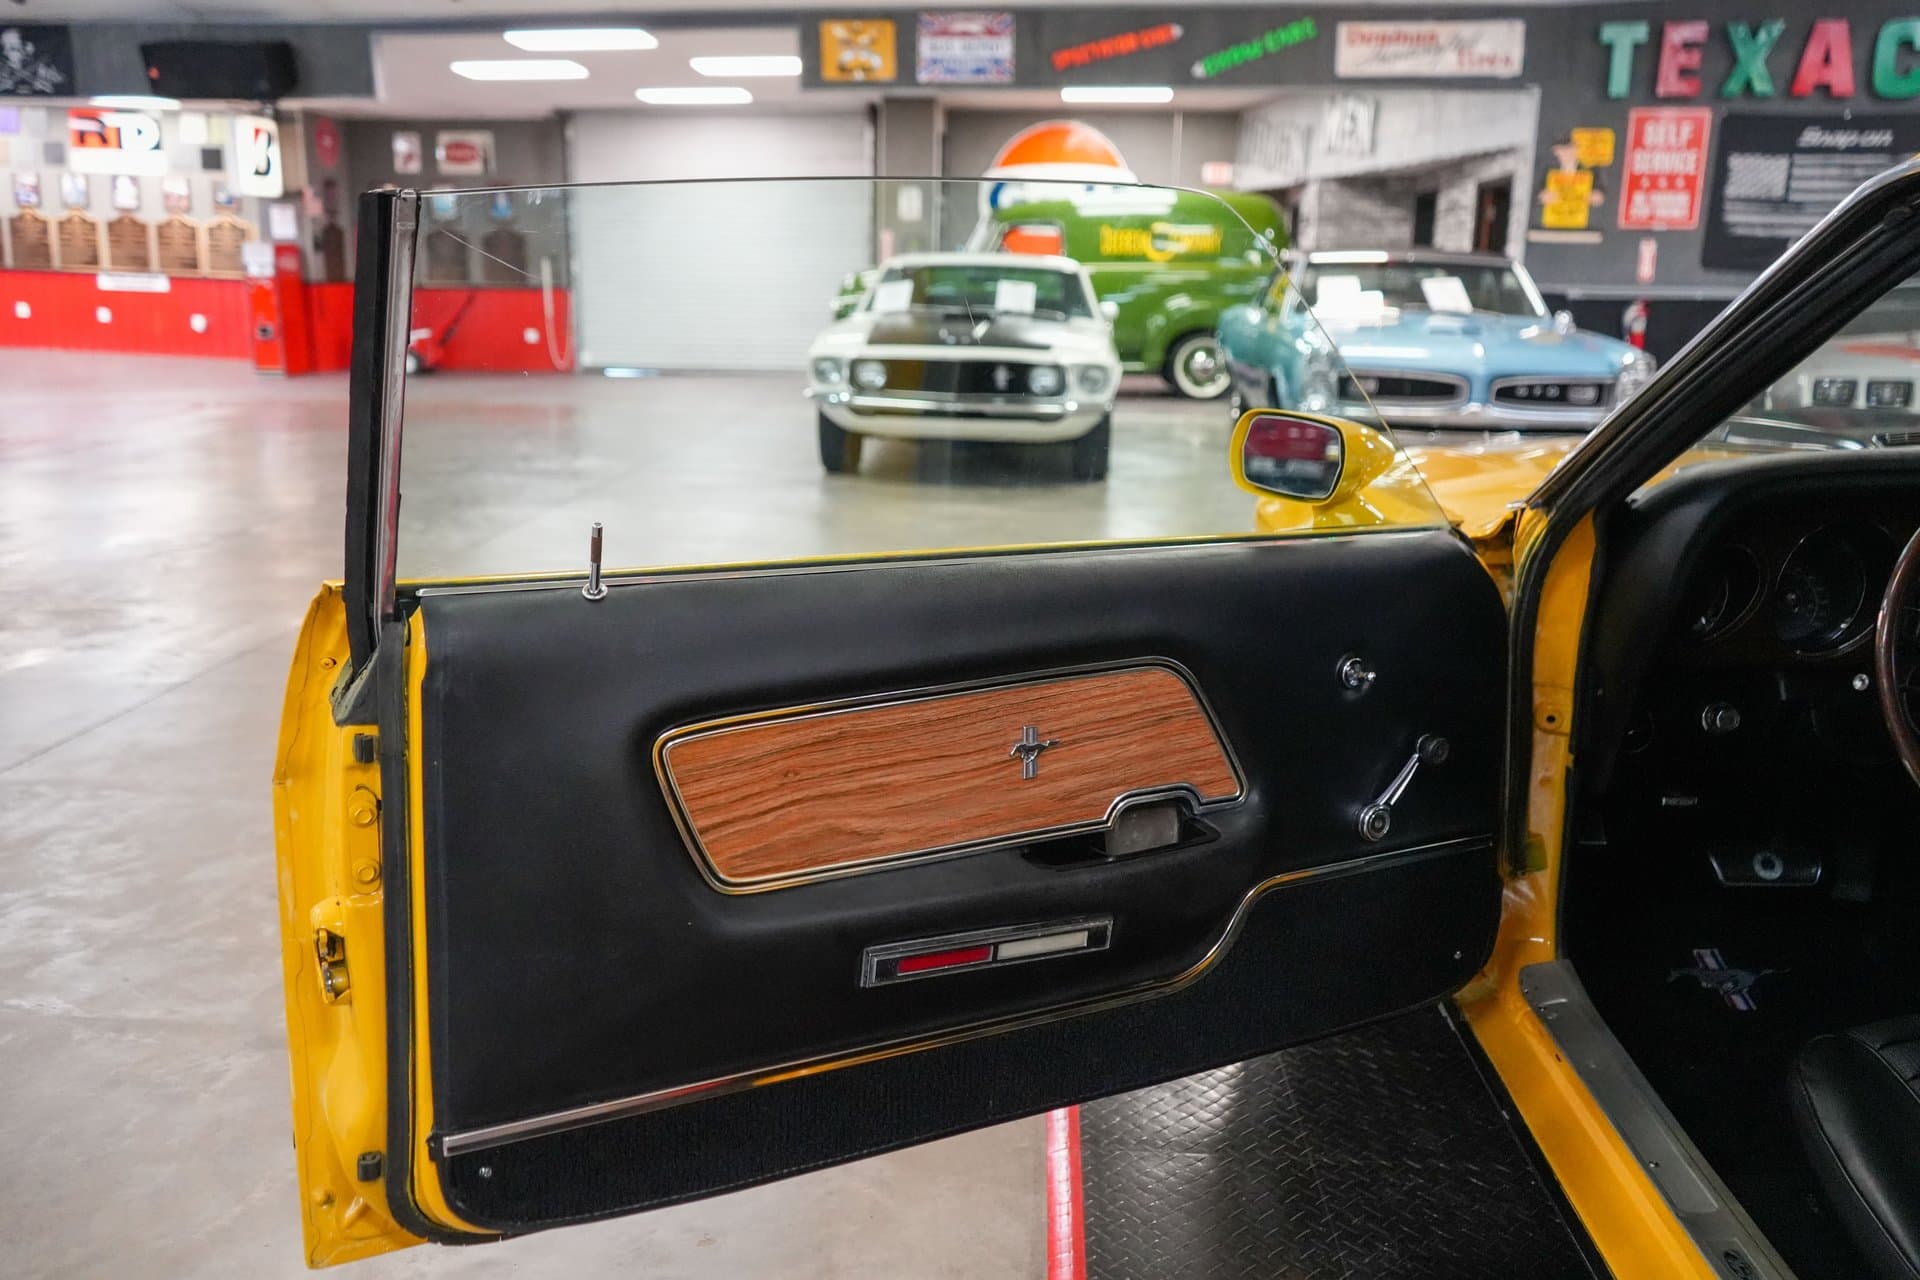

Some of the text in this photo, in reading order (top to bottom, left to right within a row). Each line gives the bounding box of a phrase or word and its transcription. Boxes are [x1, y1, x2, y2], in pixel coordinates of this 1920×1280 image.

[1600, 18, 1920, 99] TEXAC
[1643, 119, 1695, 148] SELF
[1797, 125, 1894, 150] Snap-on
[1631, 148, 1698, 176] SERVICE
